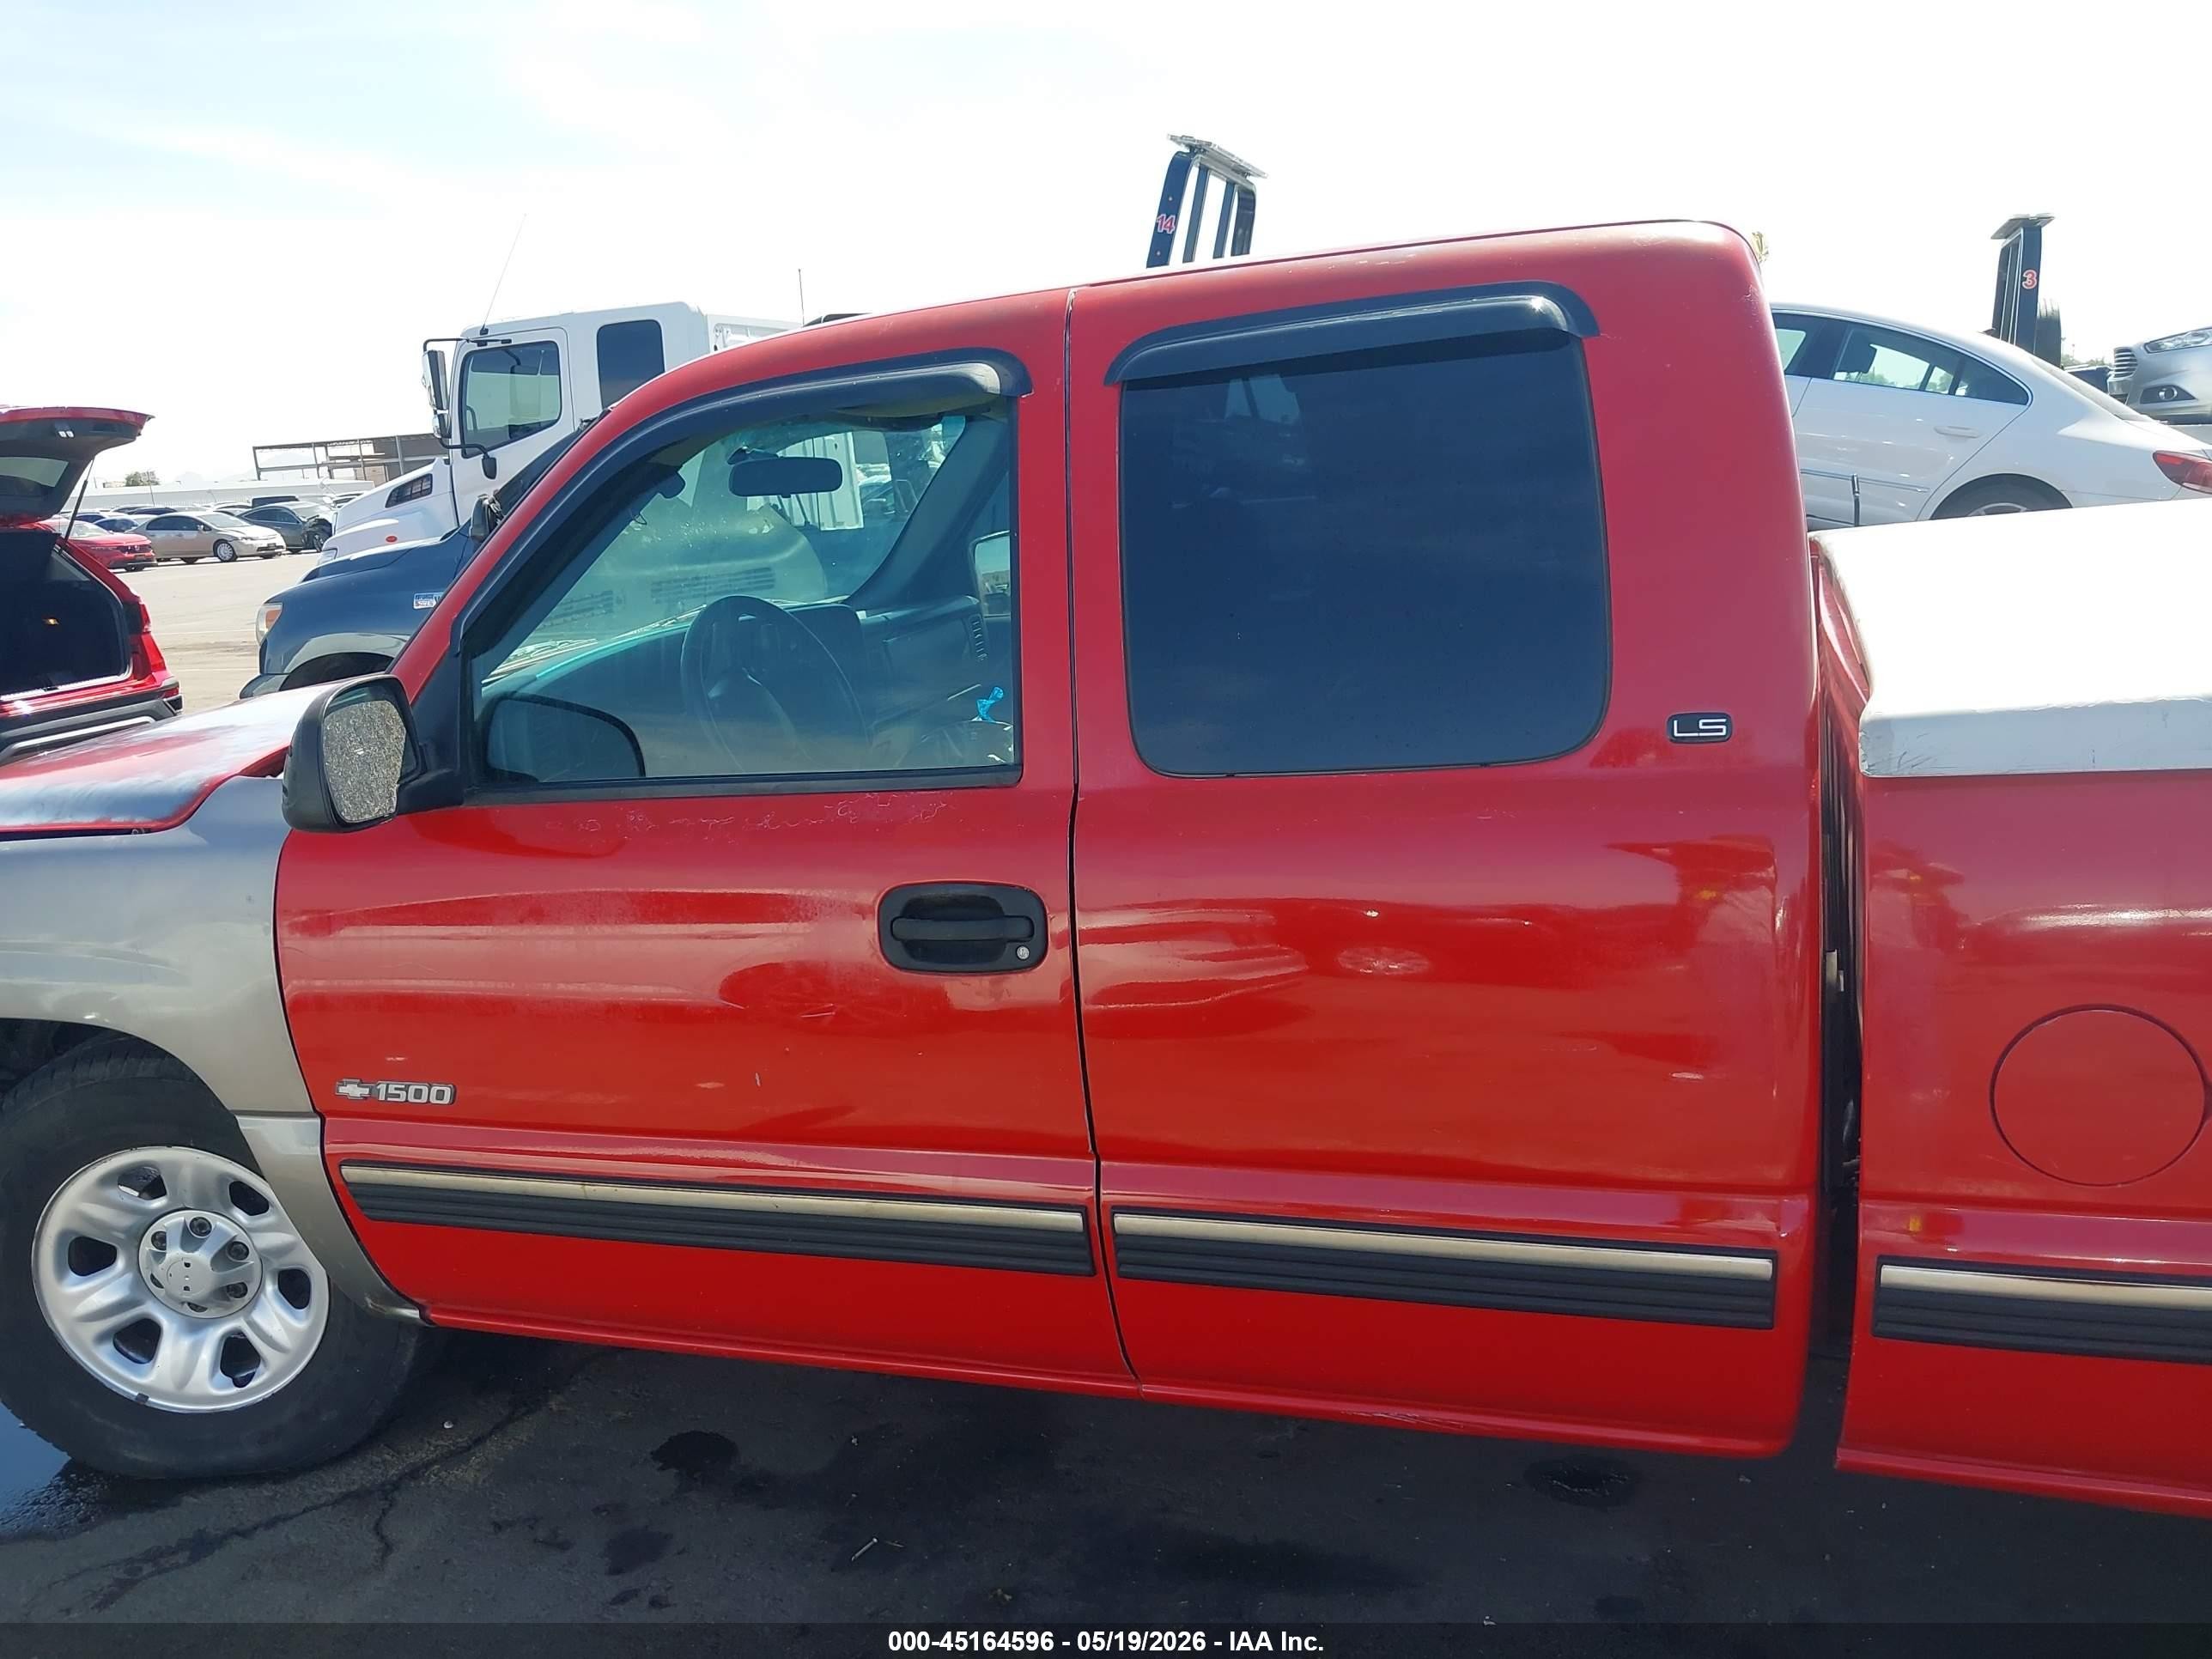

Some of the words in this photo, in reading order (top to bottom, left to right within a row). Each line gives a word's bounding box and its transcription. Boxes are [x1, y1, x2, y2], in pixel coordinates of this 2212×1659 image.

[1157, 214, 1176, 234] 14
[2022, 269, 2038, 289] 3
[1673, 718, 1728, 737] LS
[375, 1083, 452, 1105] 1500
